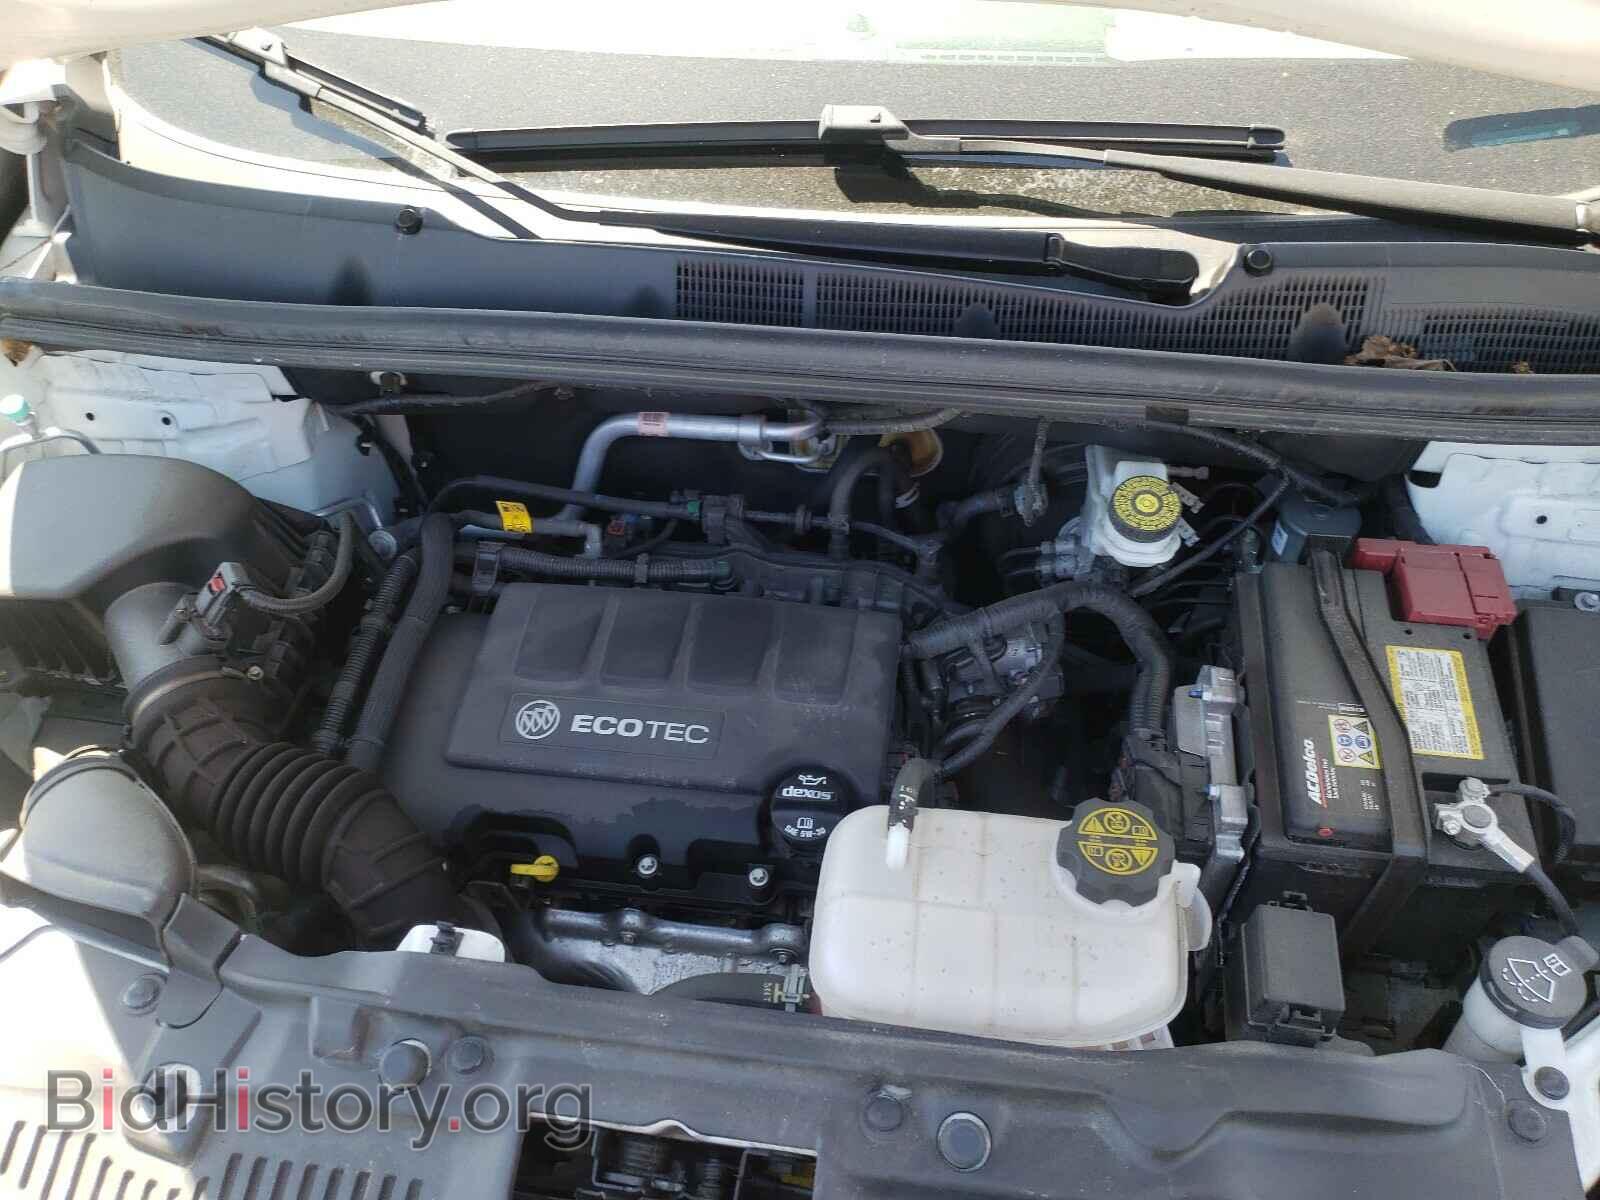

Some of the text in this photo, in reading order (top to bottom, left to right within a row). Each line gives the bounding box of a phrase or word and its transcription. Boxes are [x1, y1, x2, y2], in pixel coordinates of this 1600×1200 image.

[570, 714, 710, 744] ECOTEC
[1302, 739, 1323, 805] ACDelco
[782, 786, 832, 800] dexos
